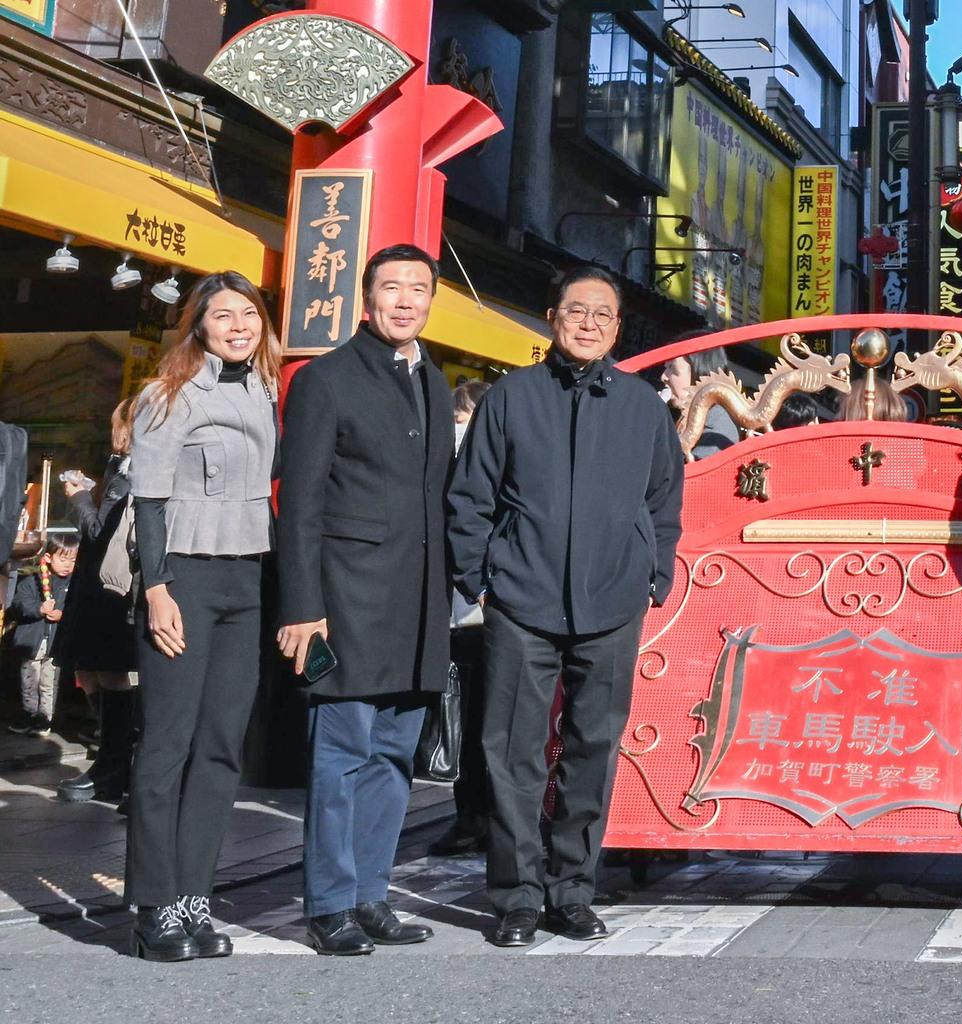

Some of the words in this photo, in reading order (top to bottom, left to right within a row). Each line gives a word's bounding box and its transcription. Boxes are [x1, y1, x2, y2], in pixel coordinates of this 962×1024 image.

[125, 208, 185, 256] 大粒甘栗
[795, 175, 814, 312] 世界一の肉まん
[814, 170, 834, 317] 中国料理世界チャンピオン
[791, 666, 918, 706] 不准
[736, 713, 959, 756] 車馬駛入
[740, 759, 941, 789] 加賀町警察署
